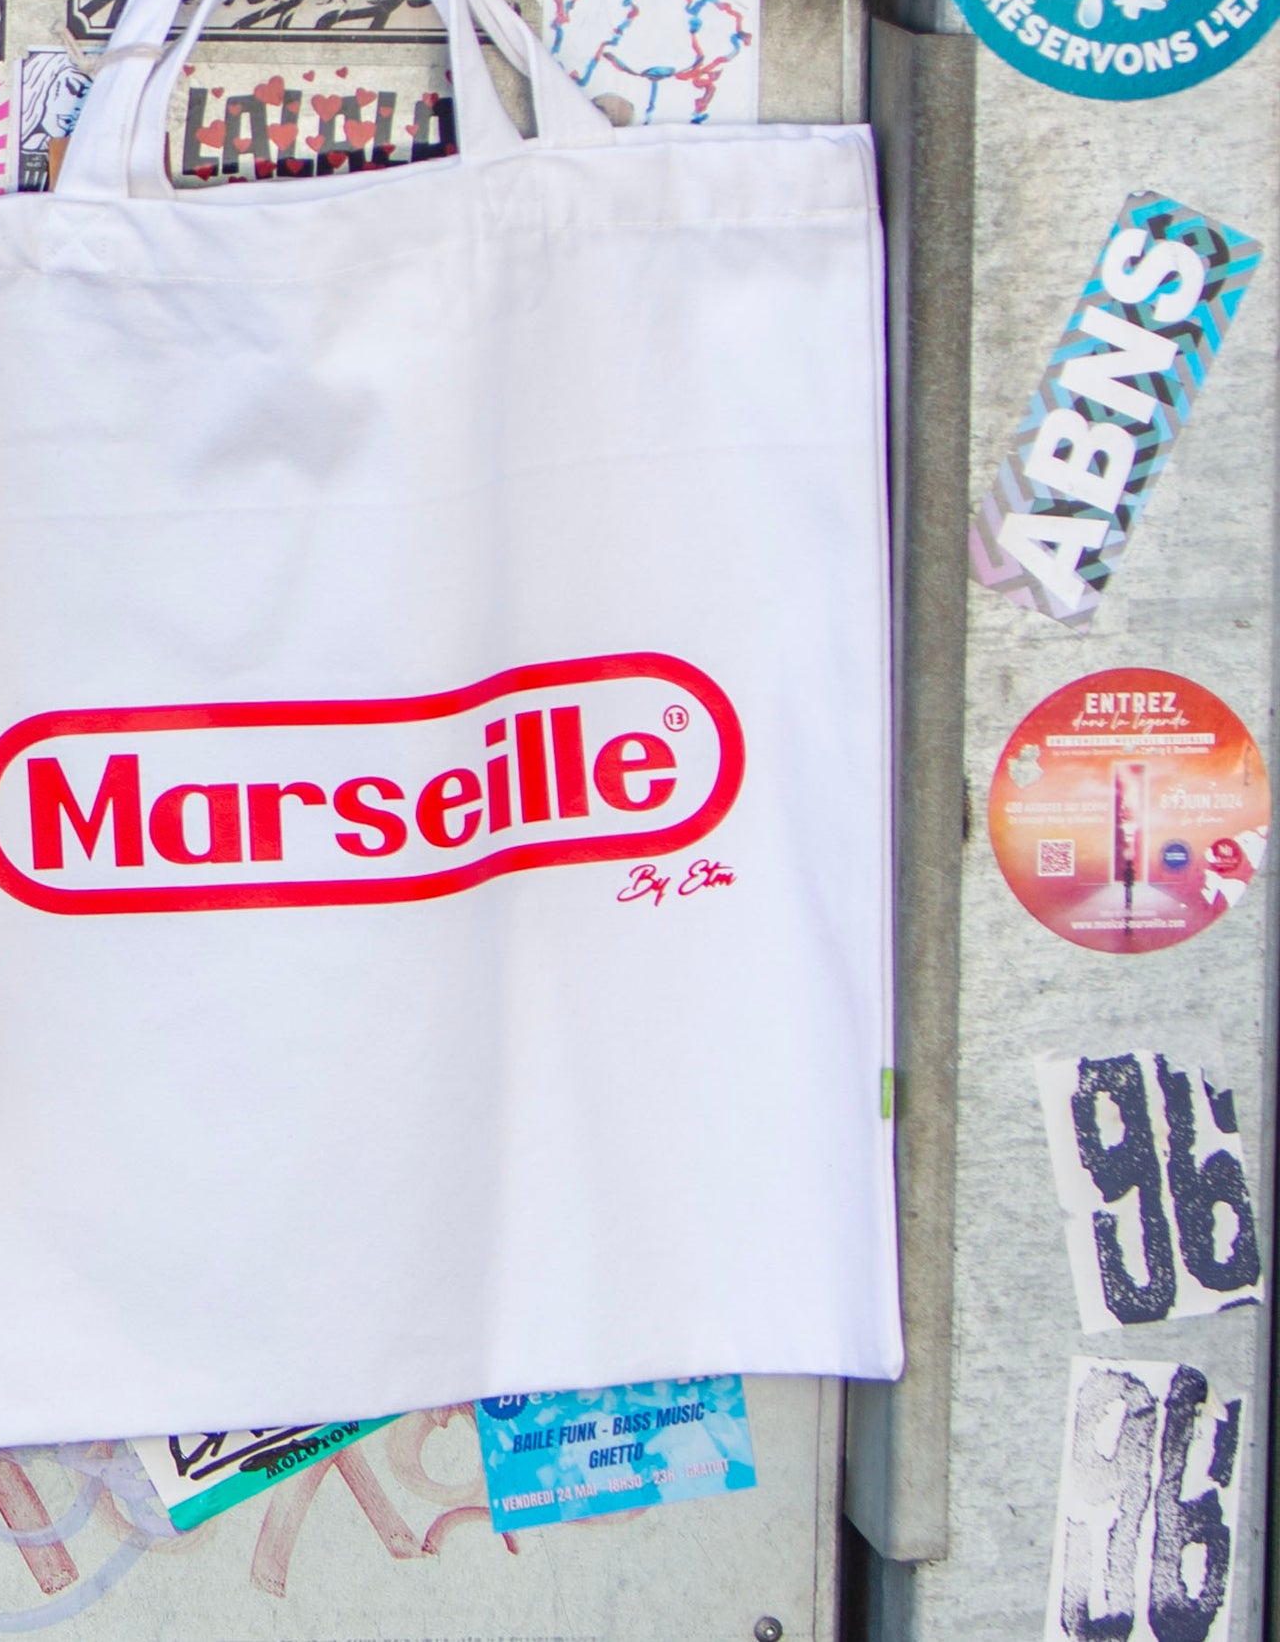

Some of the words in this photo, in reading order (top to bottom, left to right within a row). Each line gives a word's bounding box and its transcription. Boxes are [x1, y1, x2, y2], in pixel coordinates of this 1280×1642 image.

[996, 228, 1205, 610] ABNS
[1072, 710, 1108, 731] dans
[1110, 710, 1130, 731] la
[1085, 691, 1177, 714] ENTREZ
[26, 705, 678, 870] Marseille
[616, 863, 670, 906] By
[1071, 1053, 1260, 1324] 96
[266, 1421, 361, 1480] MOLOTOW
[513, 1428, 558, 1455] BAILE
[558, 1421, 598, 1447] FUNK
[612, 1410, 652, 1437] BASS
[655, 1402, 706, 1430] MUSIC
[588, 1441, 645, 1469] GHETTO
[501, 1491, 556, 1512] VENDREDI
[557, 1487, 573, 1503] 24
[574, 1481, 597, 1500] MAI
[685, 1459, 730, 1478] GRATUIT
